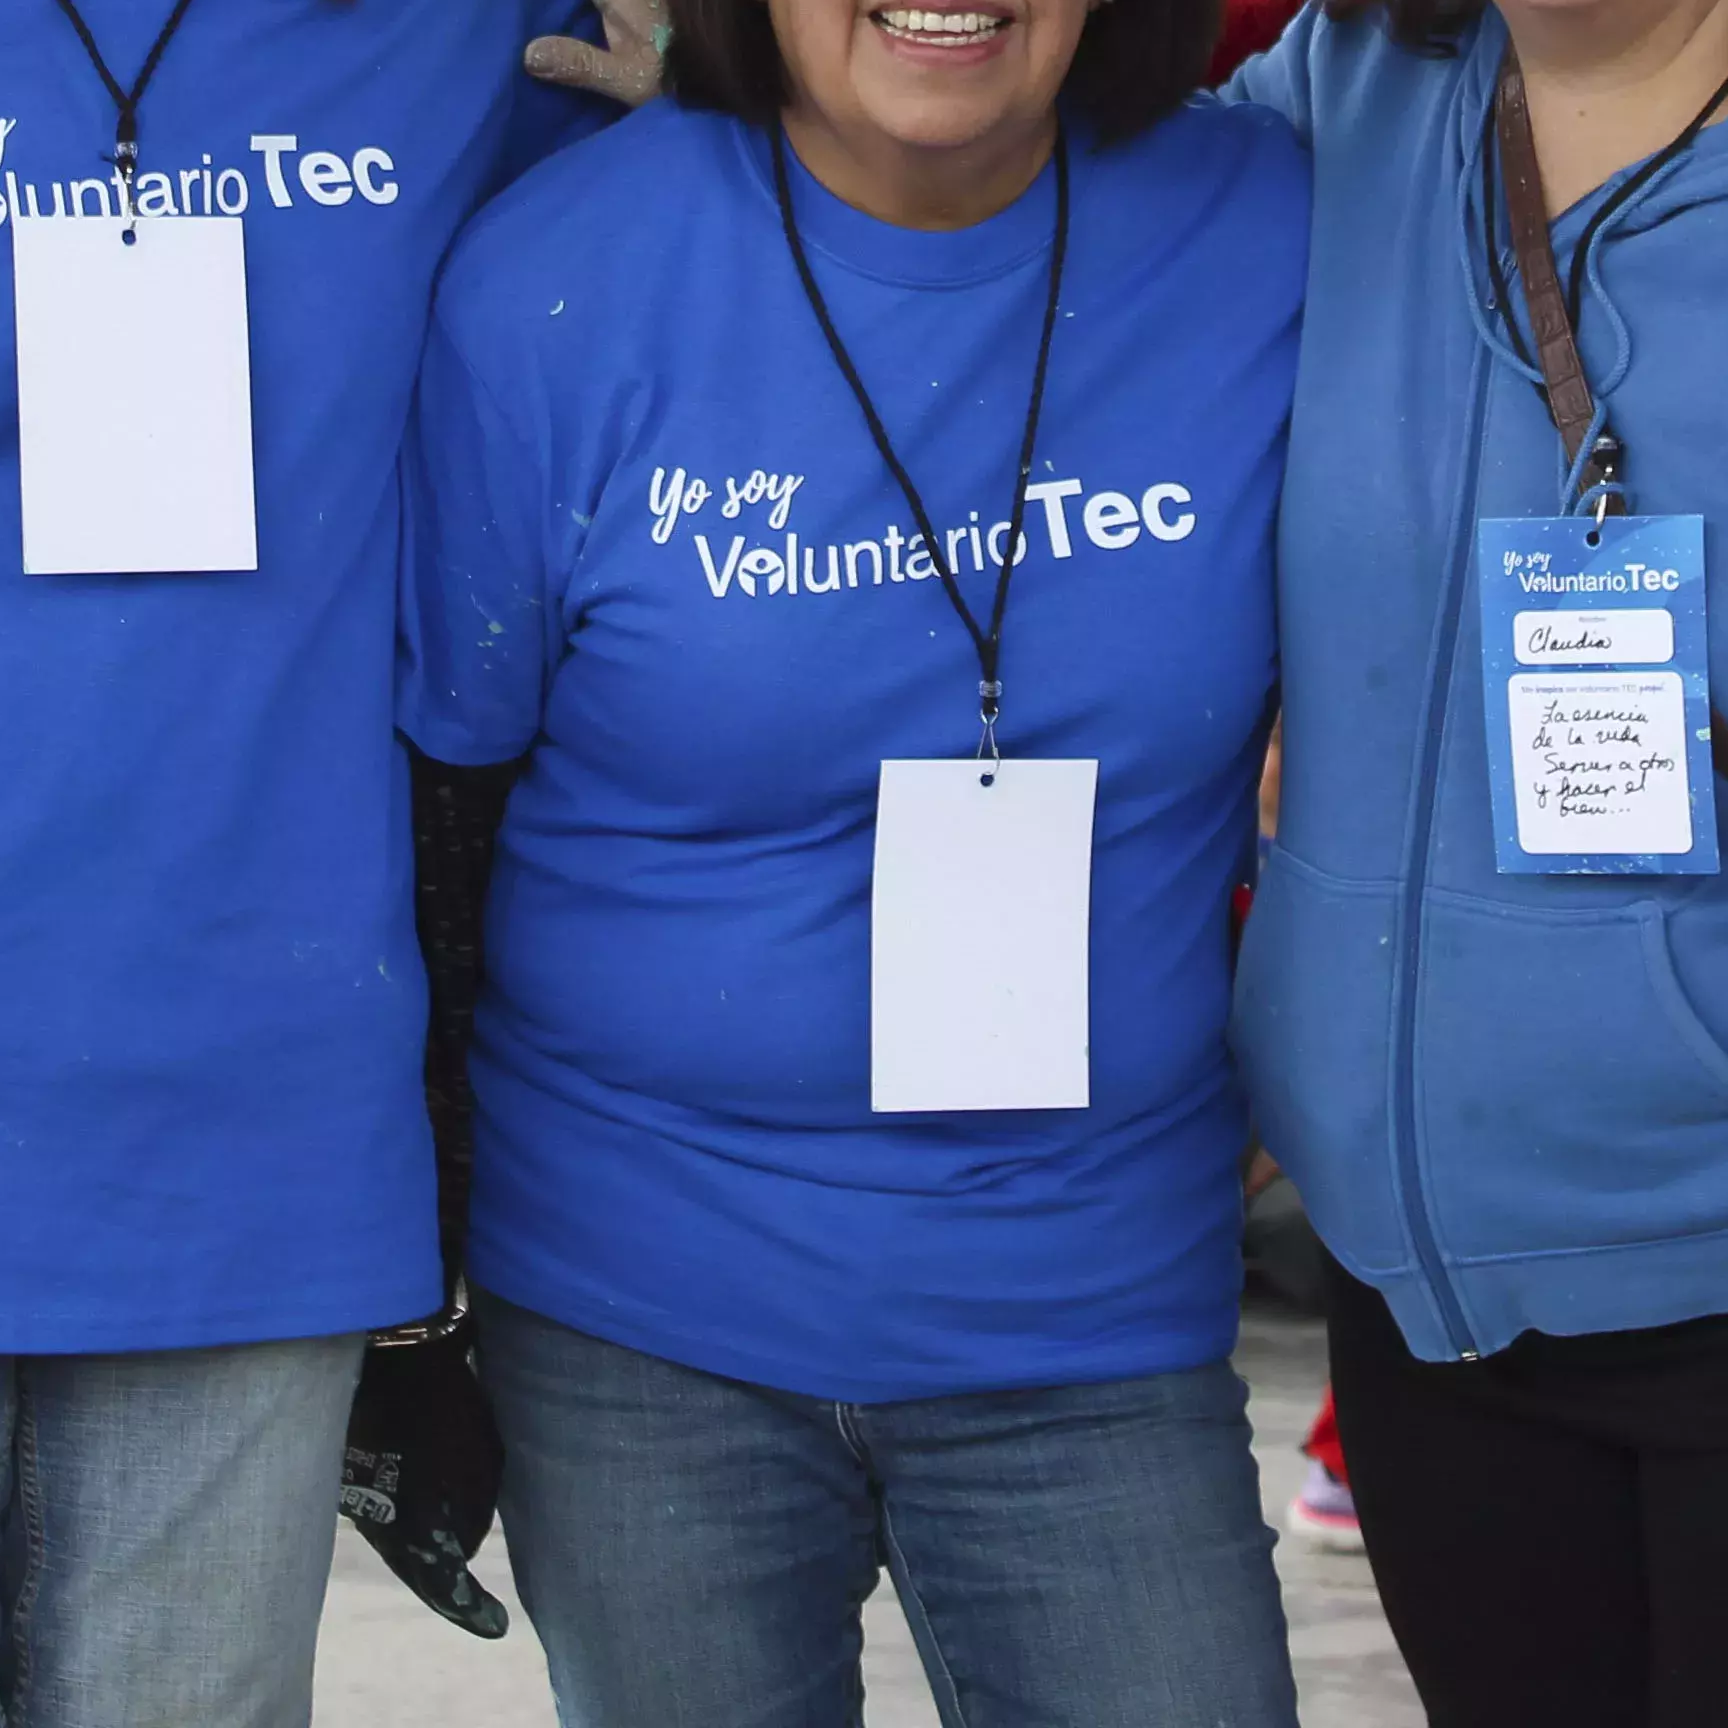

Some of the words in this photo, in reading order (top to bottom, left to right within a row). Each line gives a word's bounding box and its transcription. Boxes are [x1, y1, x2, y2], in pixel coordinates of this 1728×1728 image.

[649, 467, 712, 544] Yo
[721, 469, 805, 530] soy
[1503, 551, 1522, 576] Yo
[1526, 552, 1552, 572] soy
[1528, 625, 1613, 654] Claudia
[1541, 700, 1569, 724] La
[1532, 726, 1553, 750] de
[1568, 728, 1585, 745] la
[1533, 782, 1550, 808] y
[1625, 772, 1646, 795] el
